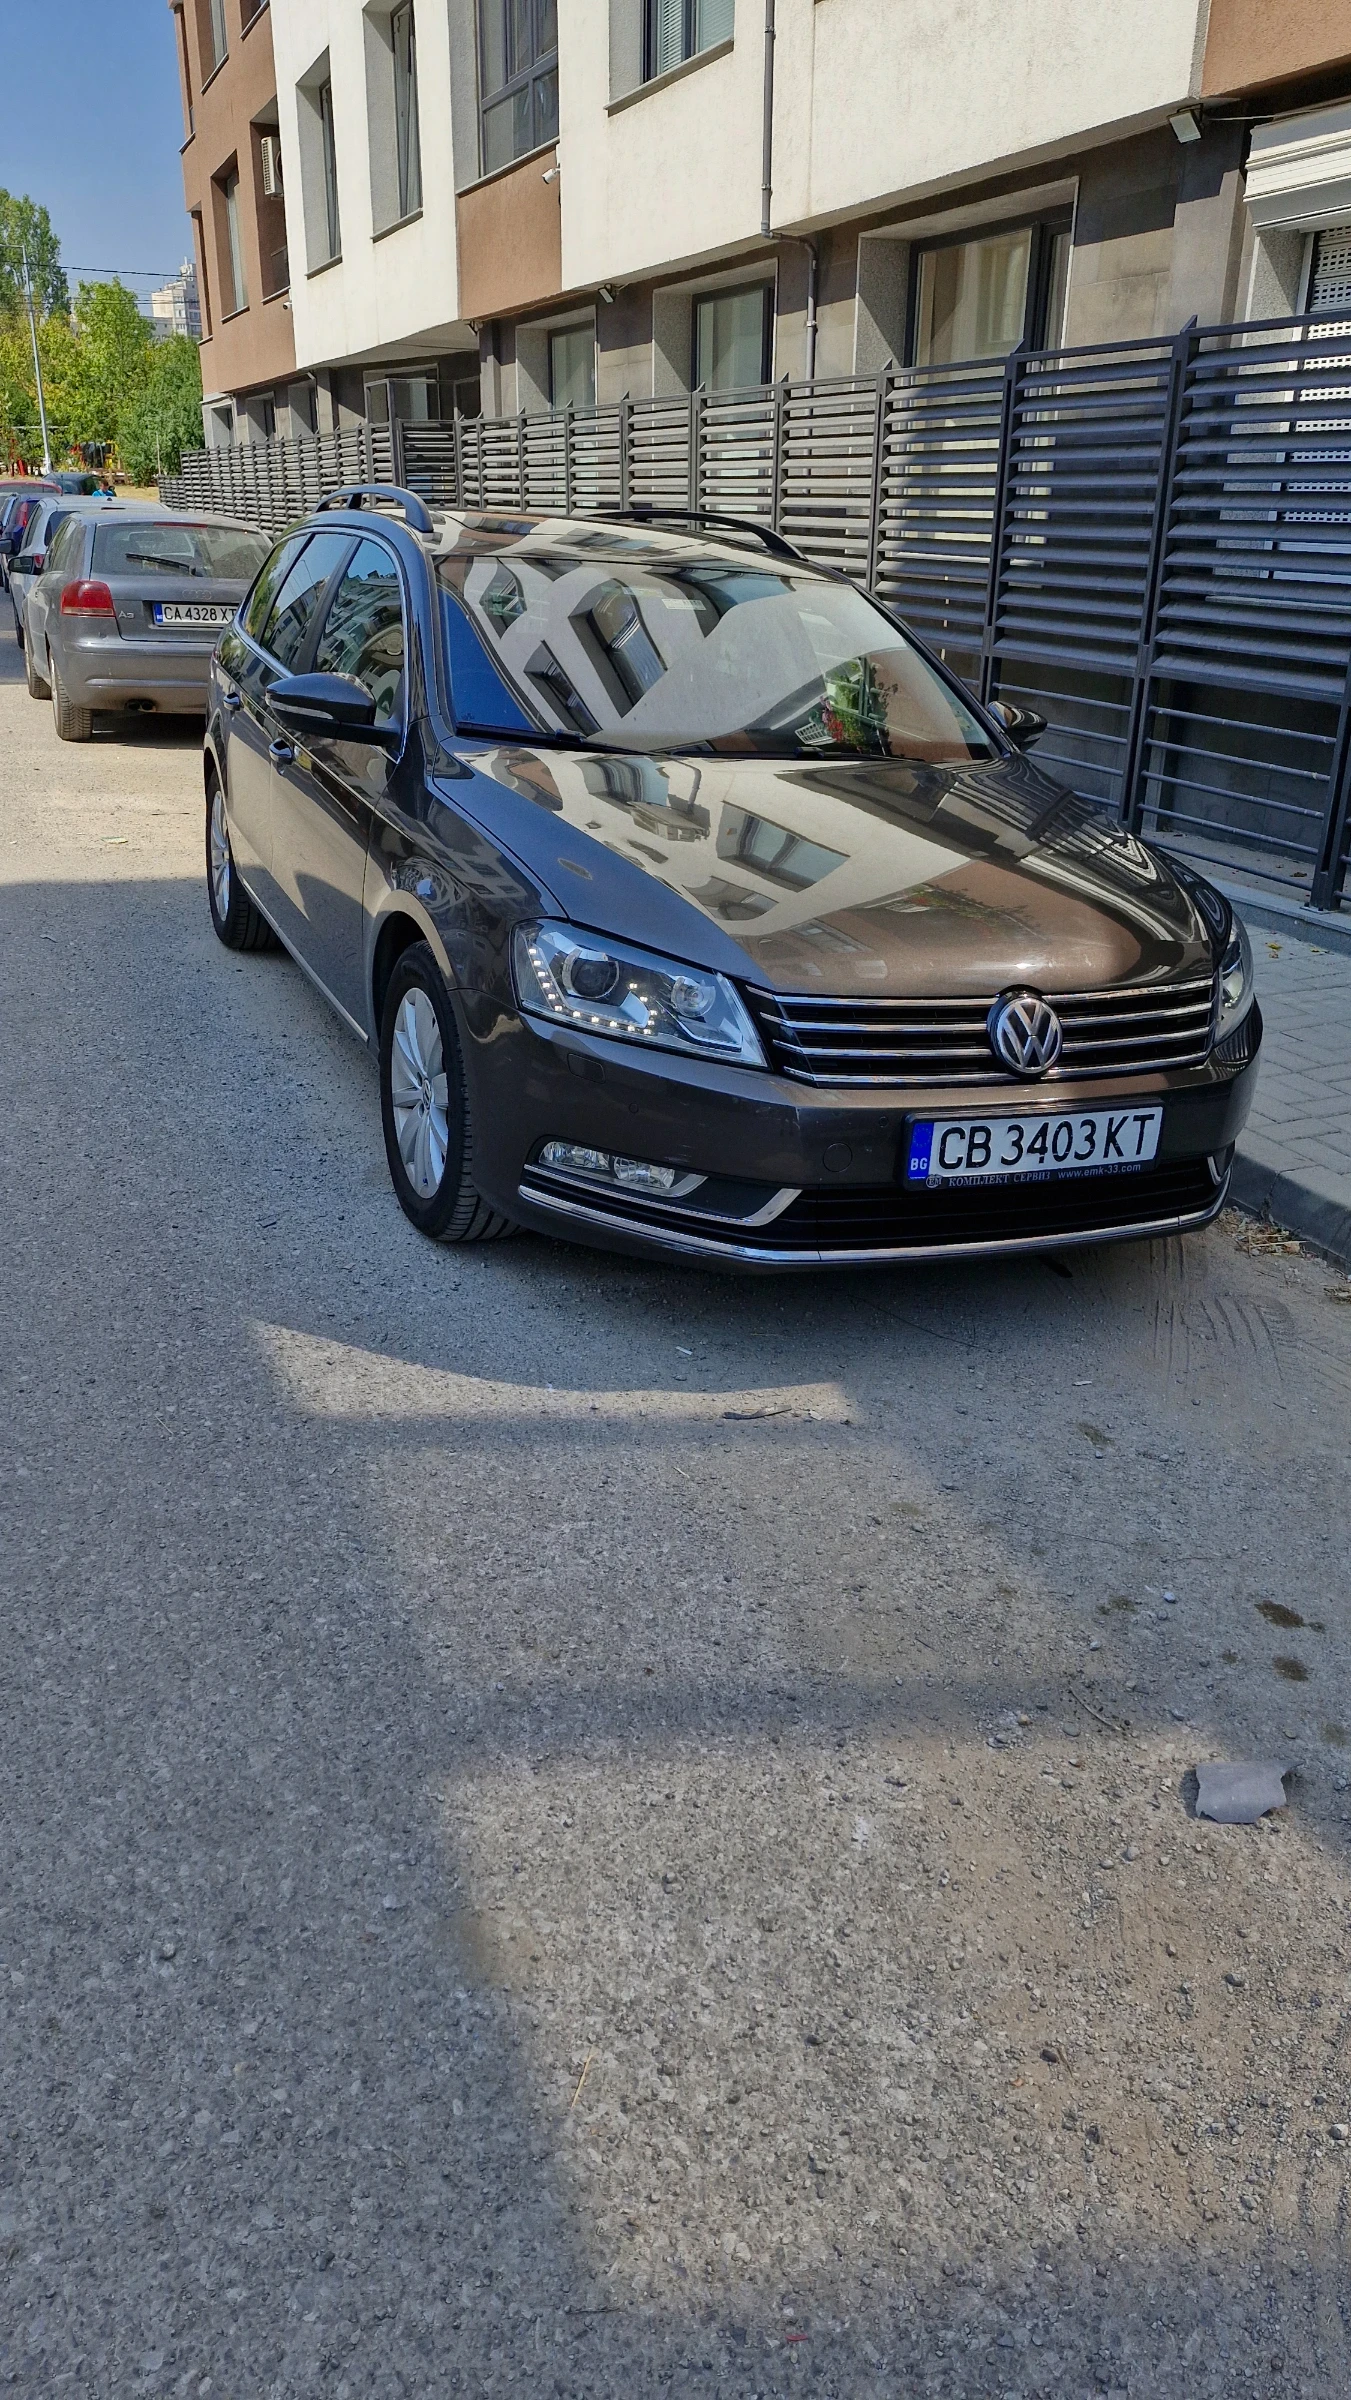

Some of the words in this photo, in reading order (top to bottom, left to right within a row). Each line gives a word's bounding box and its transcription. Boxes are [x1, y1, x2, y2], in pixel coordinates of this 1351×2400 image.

[118, 610, 135, 619] A3
[164, 606, 182, 621] CA
[185, 607, 217, 621] 4328
[938, 1126, 991, 1169] CB
[1001, 1119, 1097, 1165] 3403
[910, 1157, 928, 1171] BG
[1058, 1163, 1141, 1179] www.emk-33.com
[948, 1173, 1010, 1187] КОМПЛЕКТ
